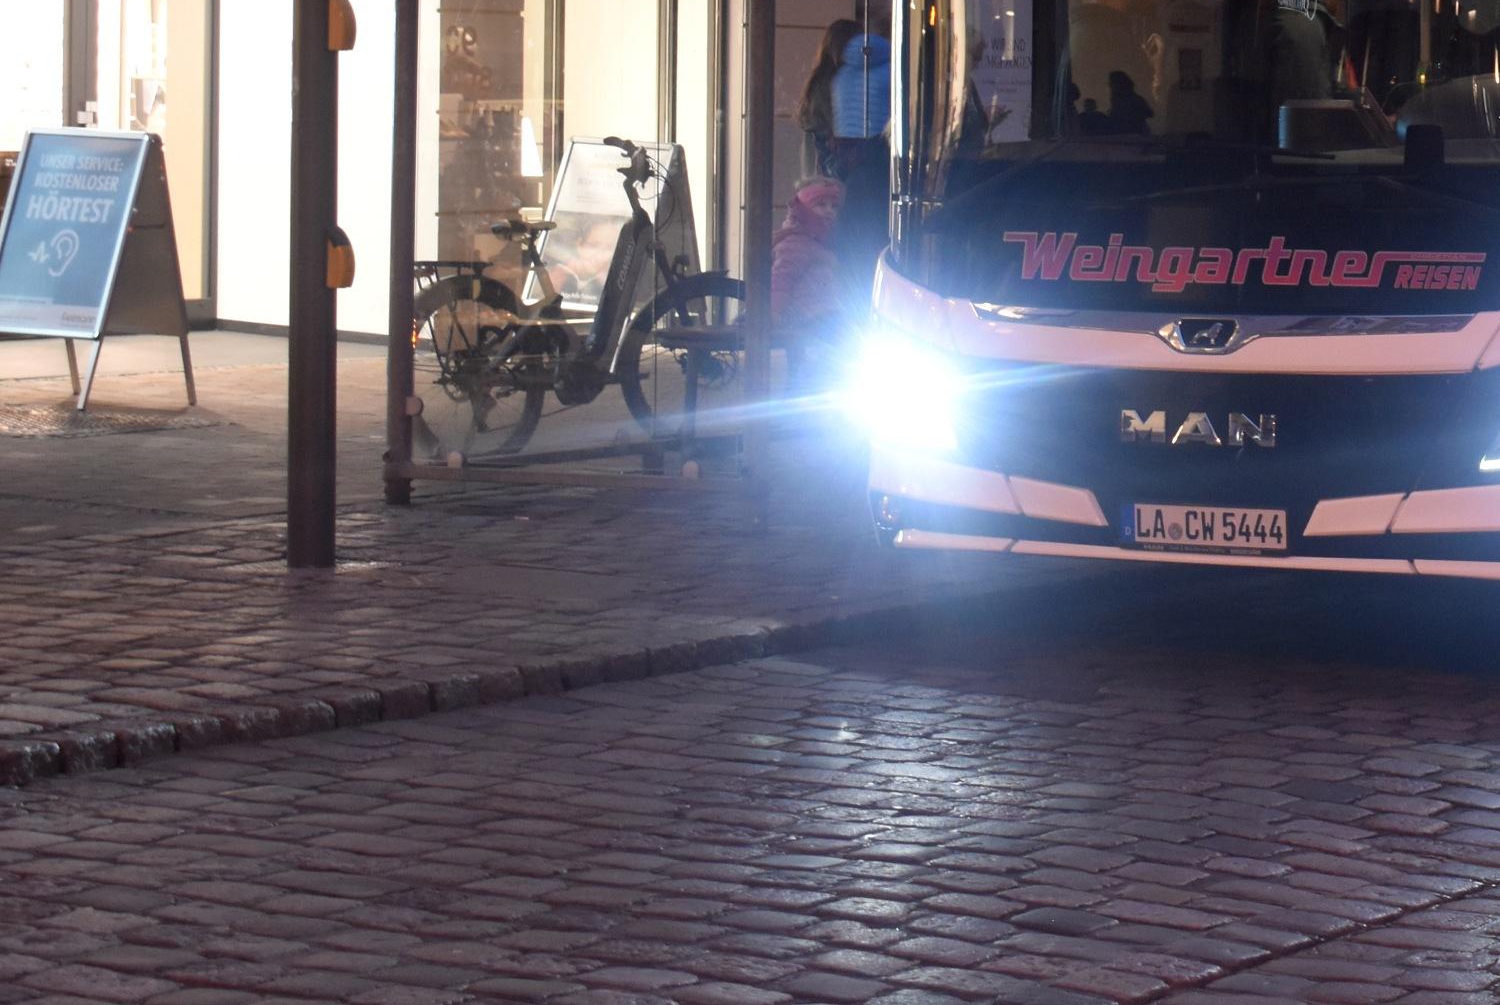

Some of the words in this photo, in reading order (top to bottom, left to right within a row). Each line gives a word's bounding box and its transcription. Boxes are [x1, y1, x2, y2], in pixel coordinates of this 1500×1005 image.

[40, 153, 76, 170] UNSER
[77, 156, 125, 173] SERVICE:
[34, 172, 120, 193] KOSTENLOSER
[26, 190, 115, 224] HÖRTEST
[1003, 231, 1487, 293] Weingartner
[1393, 264, 1482, 291] REISEN
[1121, 408, 1278, 448] MAN
[1136, 507, 1166, 539] LA
[1185, 510, 1215, 542] CW
[1223, 512, 1283, 544] 5444
